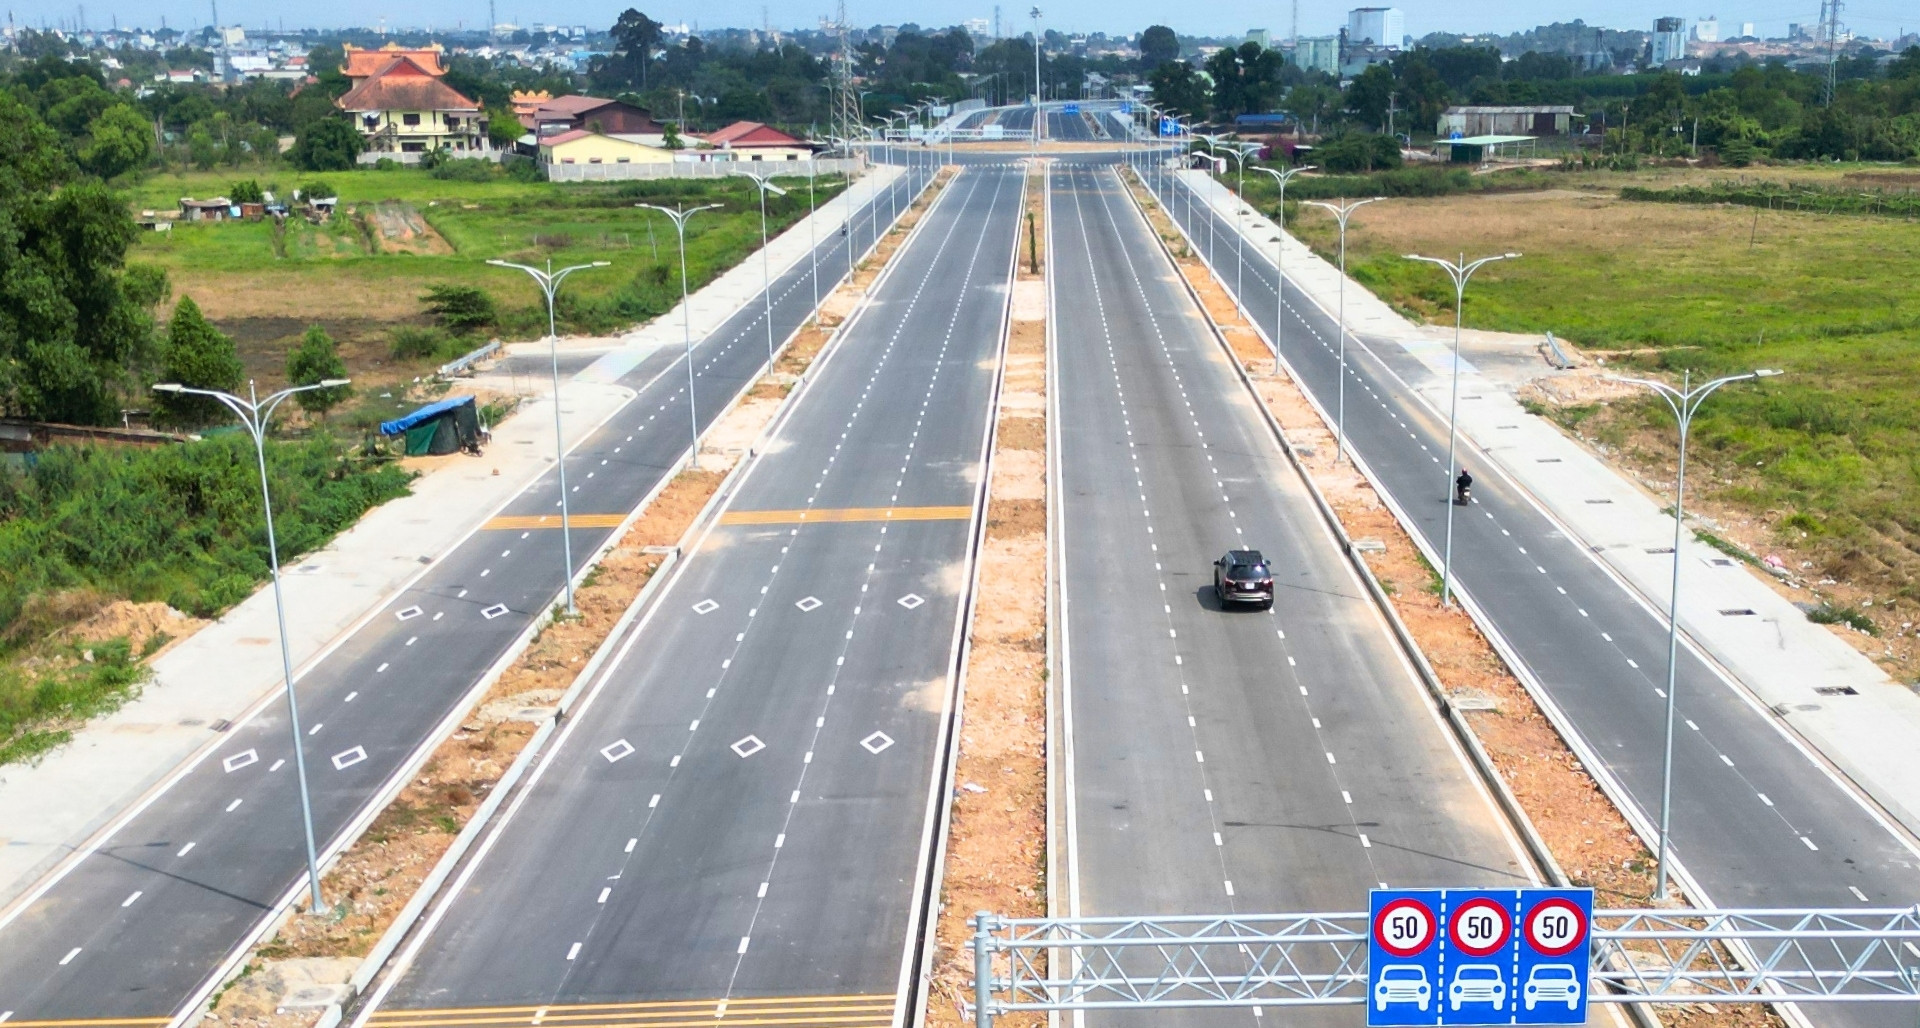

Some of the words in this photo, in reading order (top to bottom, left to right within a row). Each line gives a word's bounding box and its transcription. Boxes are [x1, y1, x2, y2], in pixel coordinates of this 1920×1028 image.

[1392, 916, 1418, 939] 50
[1467, 916, 1493, 939] 50
[1542, 915, 1568, 939] 50
